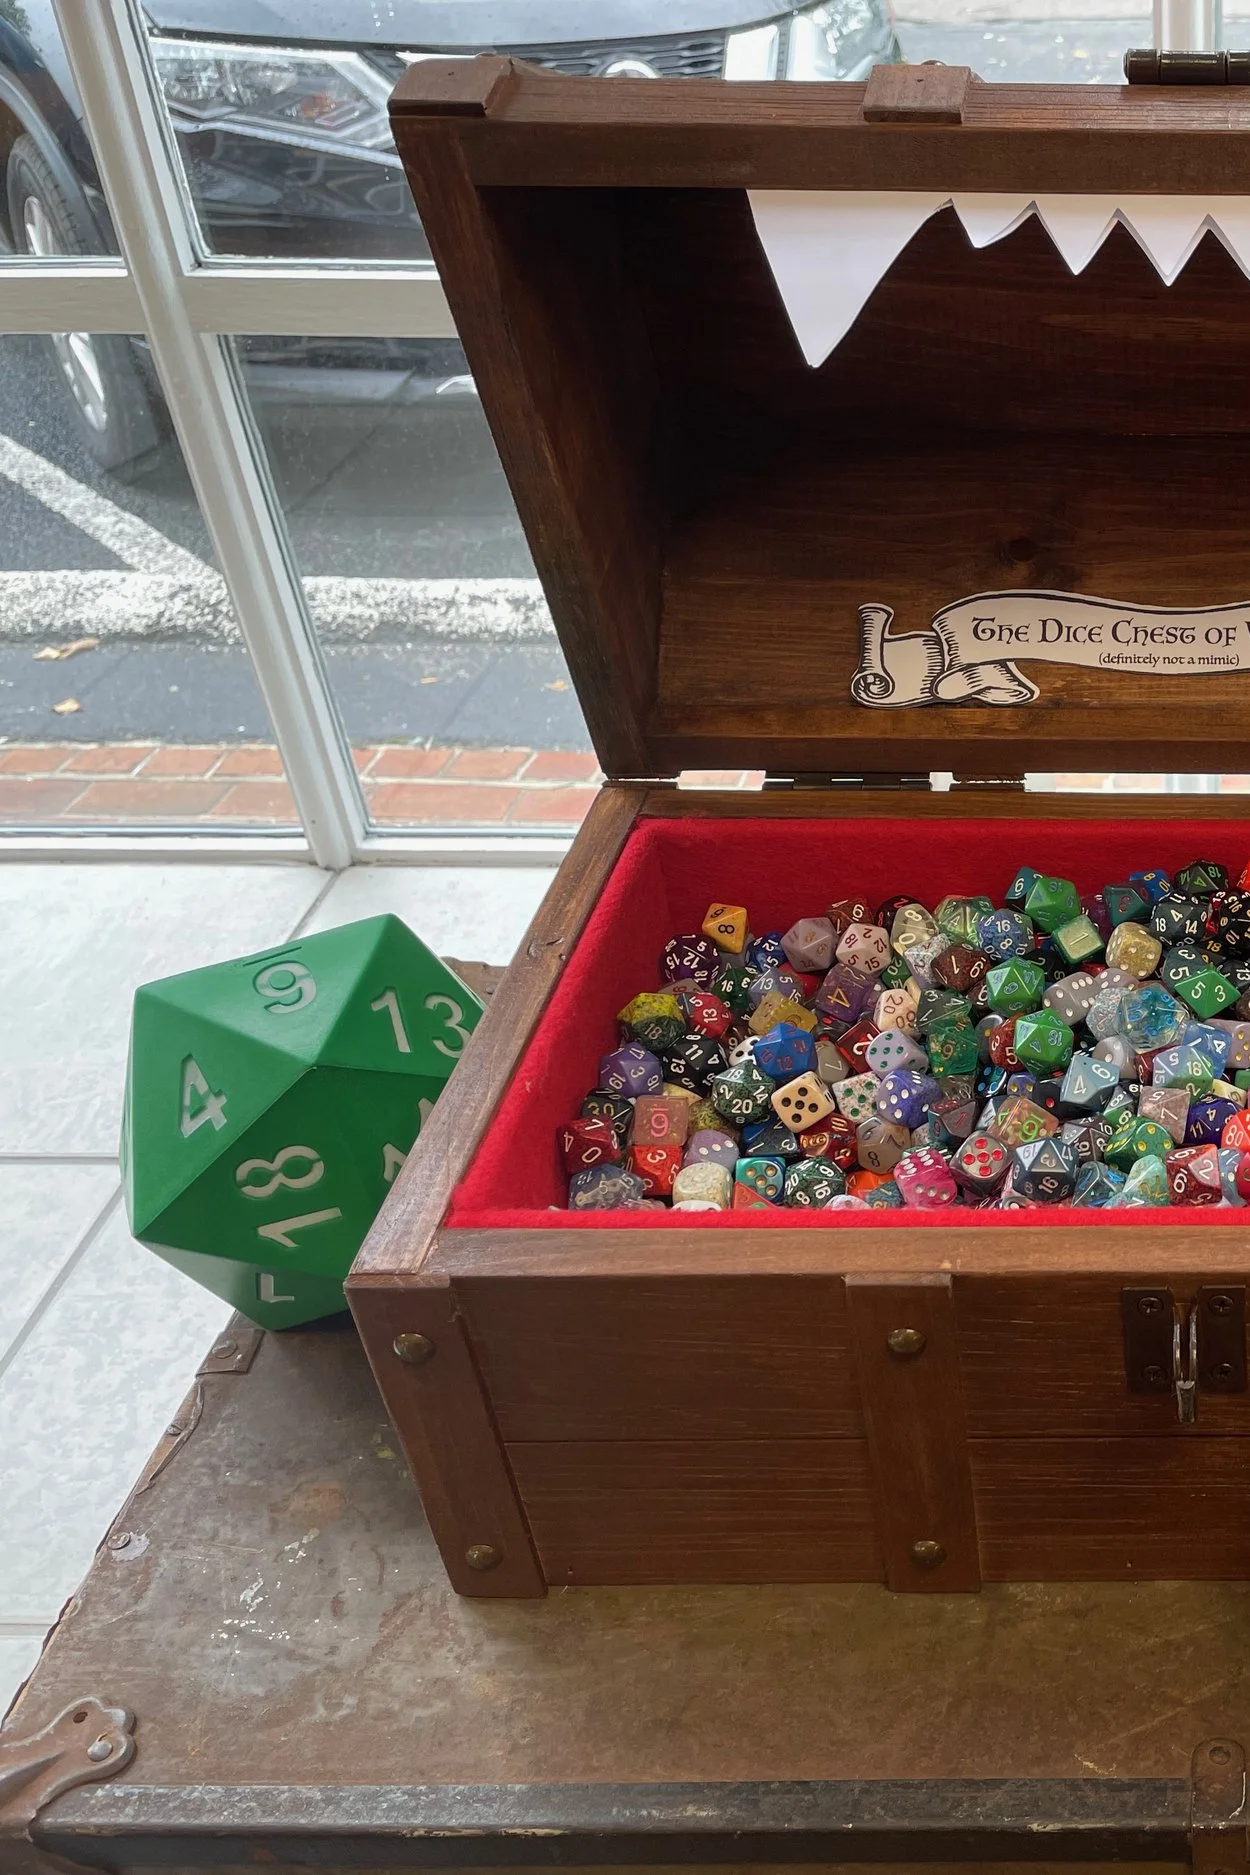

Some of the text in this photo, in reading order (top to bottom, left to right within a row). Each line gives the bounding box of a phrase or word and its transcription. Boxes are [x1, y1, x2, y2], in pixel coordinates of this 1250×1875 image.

[1098, 652, 1240, 667] (definitely not a mimic)
[1170, 909, 1183, 922] 4
[718, 924, 735, 934] 8
[996, 920, 1010, 932] 16
[1155, 917, 1167, 932] 18
[1185, 919, 1198, 934] 14
[1000, 938, 1013, 949] 8
[865, 957, 880, 971] 15
[721, 980, 734, 992] 16
[1191, 981, 1206, 999] 5
[1215, 985, 1226, 1002] 3
[370, 986, 474, 1058] 13
[1187, 1061, 1202, 1076] 18
[719, 1084, 733, 1100] 2
[1073, 1075, 1087, 1094] 4
[178, 1053, 228, 1139] 4
[731, 1098, 753, 1114] 20
